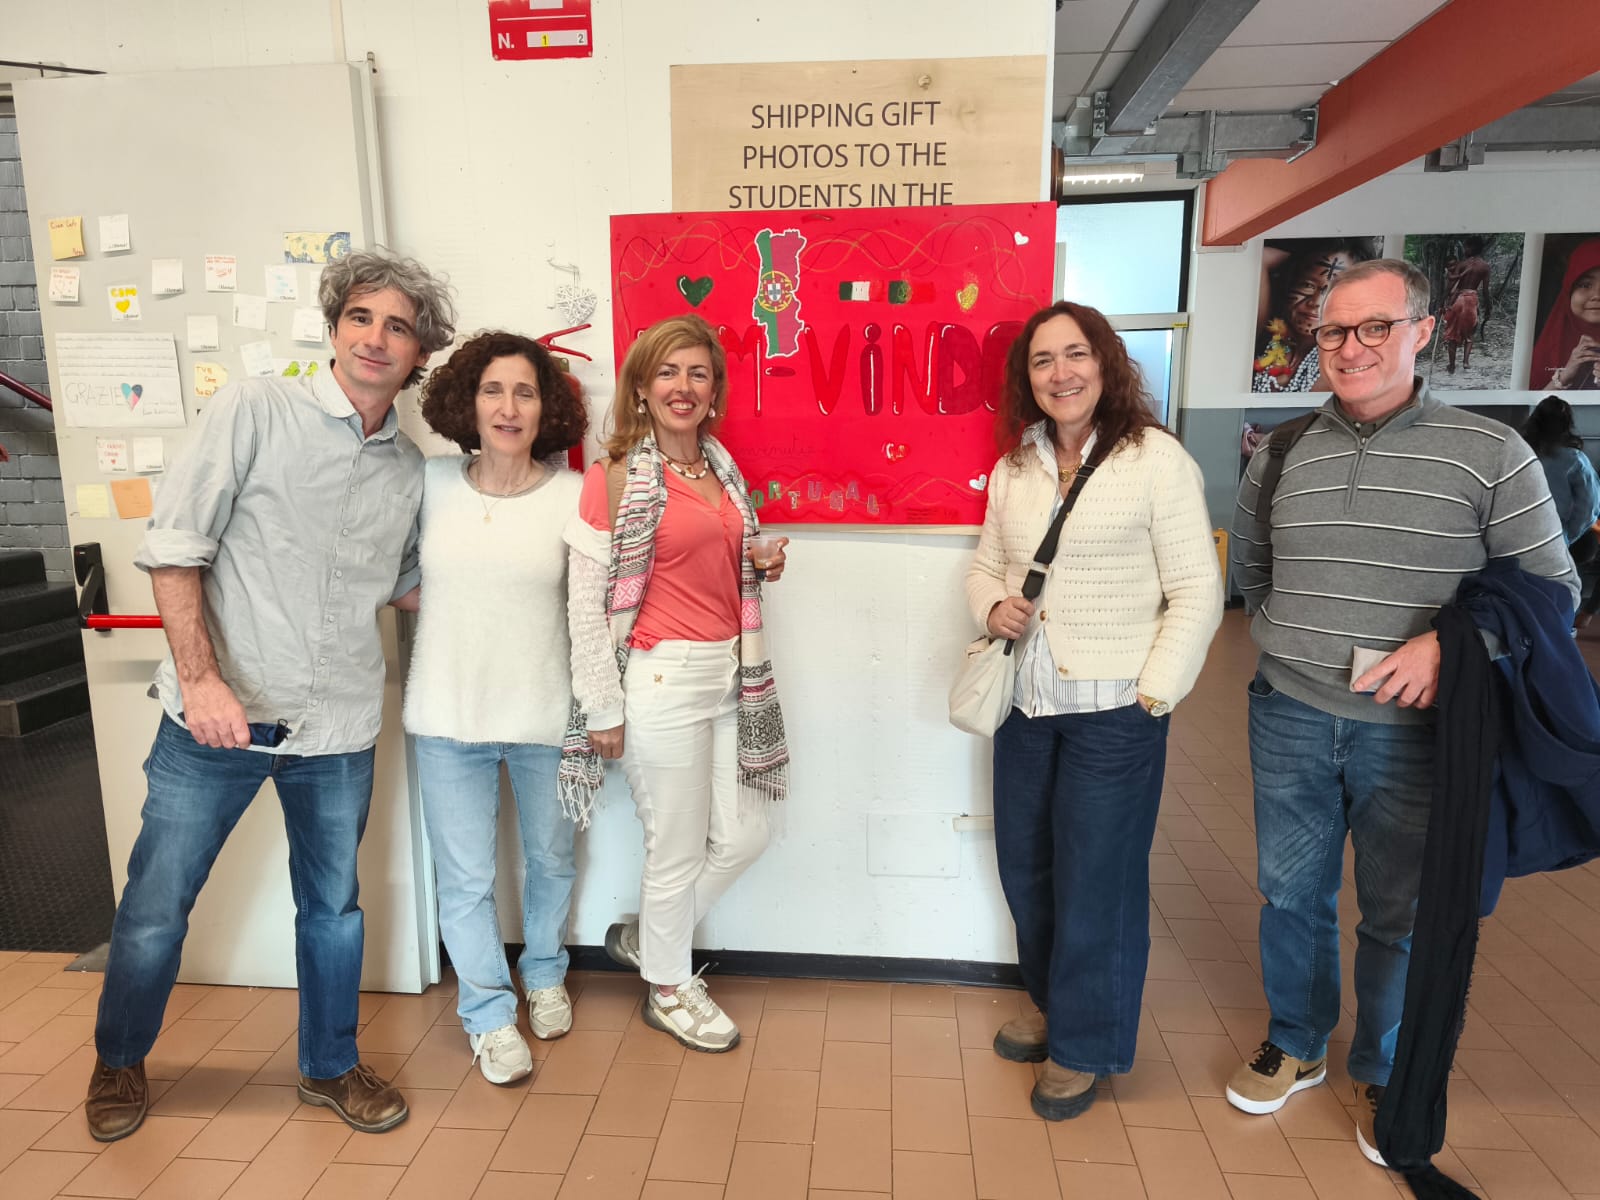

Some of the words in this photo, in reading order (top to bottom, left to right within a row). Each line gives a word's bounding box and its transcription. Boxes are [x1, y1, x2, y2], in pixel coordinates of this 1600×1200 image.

[497, 32, 515, 49] N.
[542, 34, 548, 46] 1
[577, 33, 585, 44] 2
[751, 102, 873, 129] SHIPPING
[881, 101, 941, 127] GIFT
[743, 143, 849, 169] PHOTOS
[854, 143, 890, 168] TO
[896, 142, 947, 167] THE
[729, 183, 862, 209] STUDENTS
[871, 183, 896, 208] IN
[902, 182, 953, 207] THE
[65, 382, 128, 407] GRAZIE
[744, 480, 880, 515] ORTUGAL
